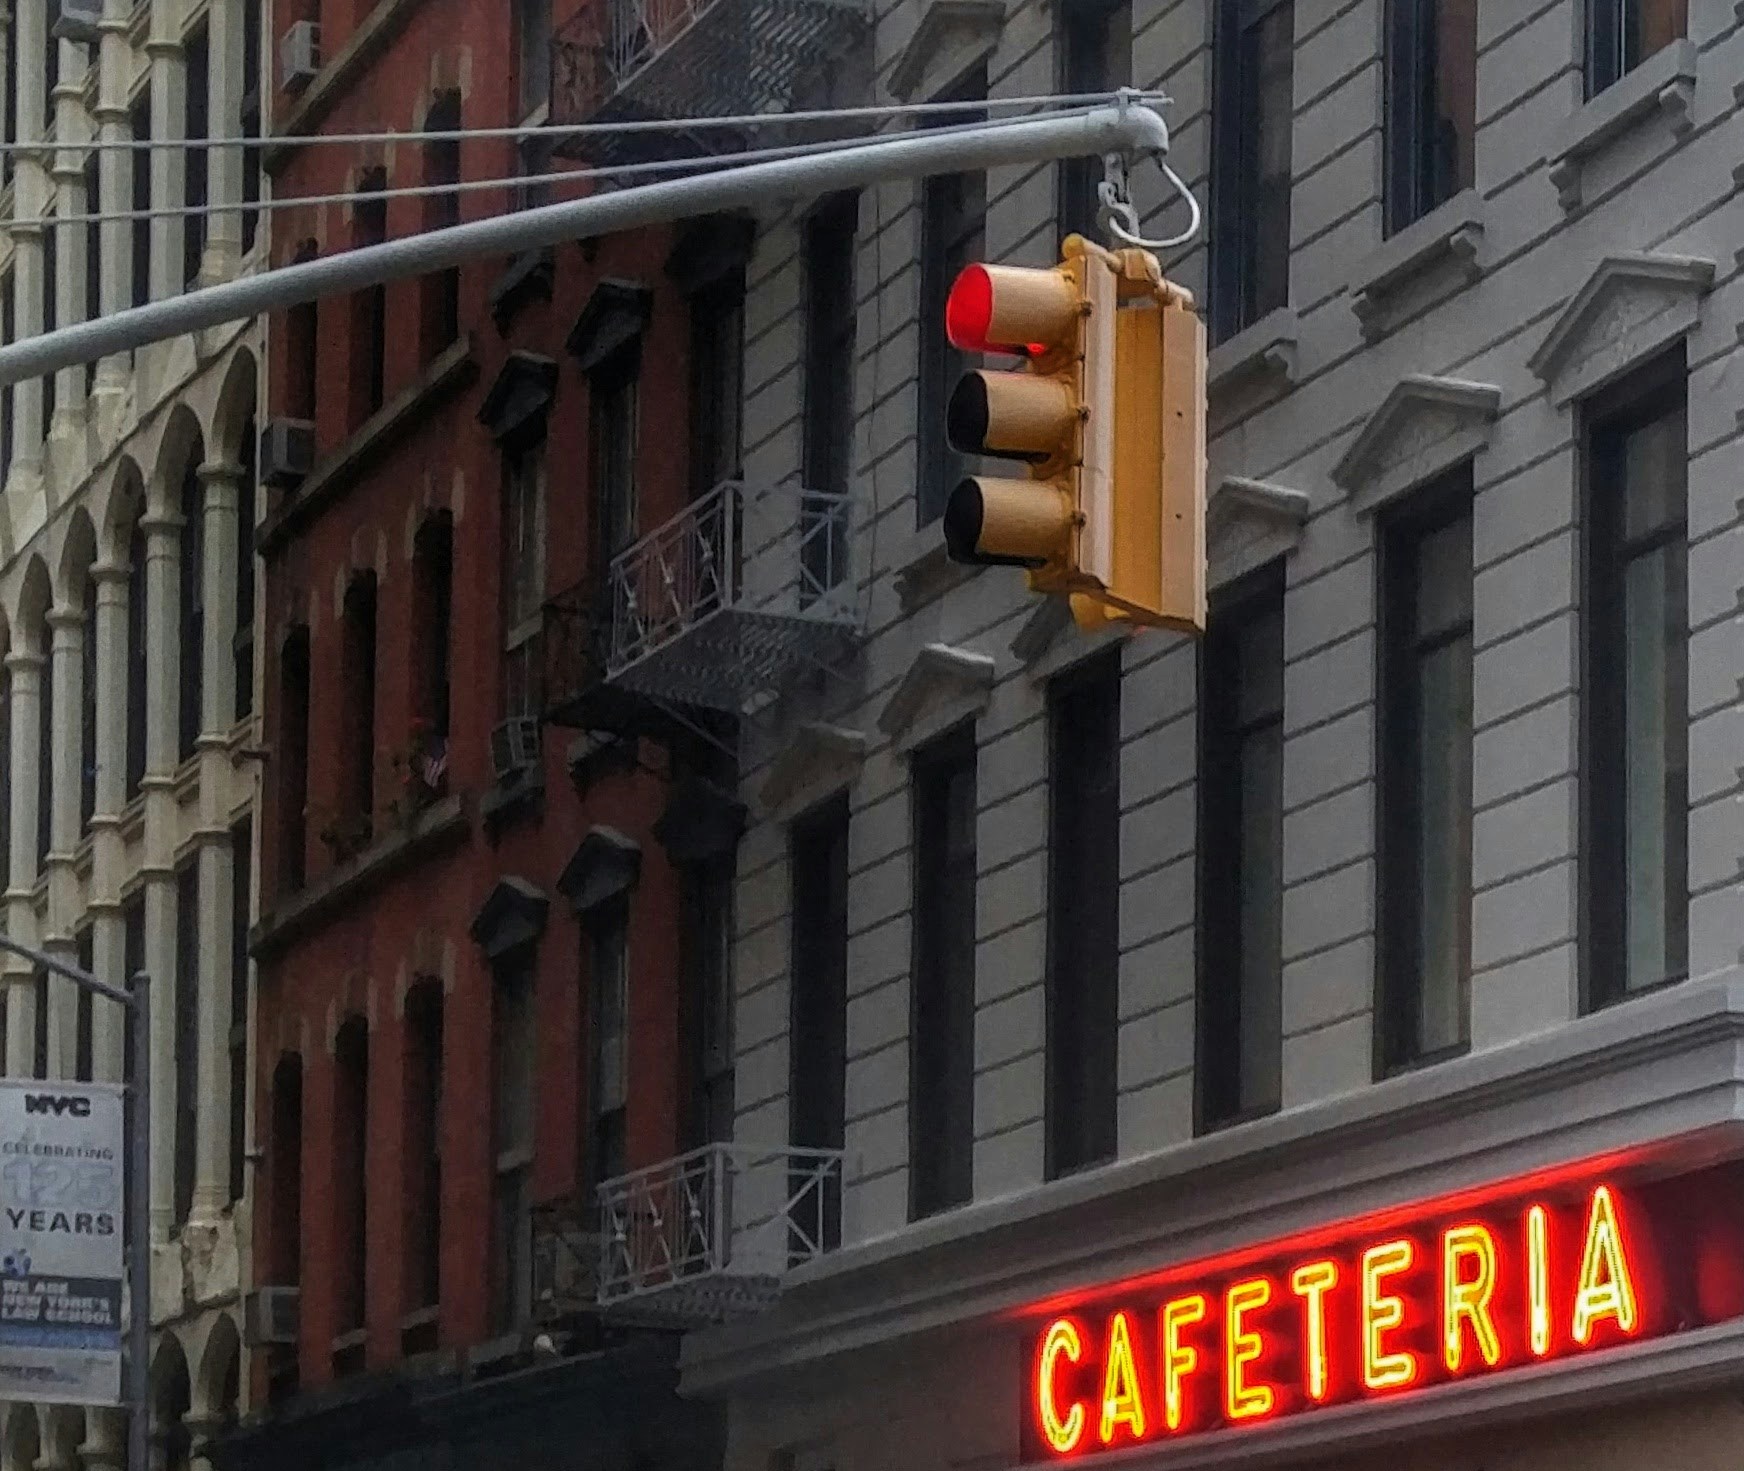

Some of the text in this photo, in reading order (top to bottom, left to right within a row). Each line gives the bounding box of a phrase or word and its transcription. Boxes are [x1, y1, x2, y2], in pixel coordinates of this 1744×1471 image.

[25, 1094, 91, 1117] NYC
[3, 1141, 113, 1160] CELEBRATING
[7, 1208, 115, 1236] YEARS
[1039, 1185, 1638, 1453] CAFETERIA
